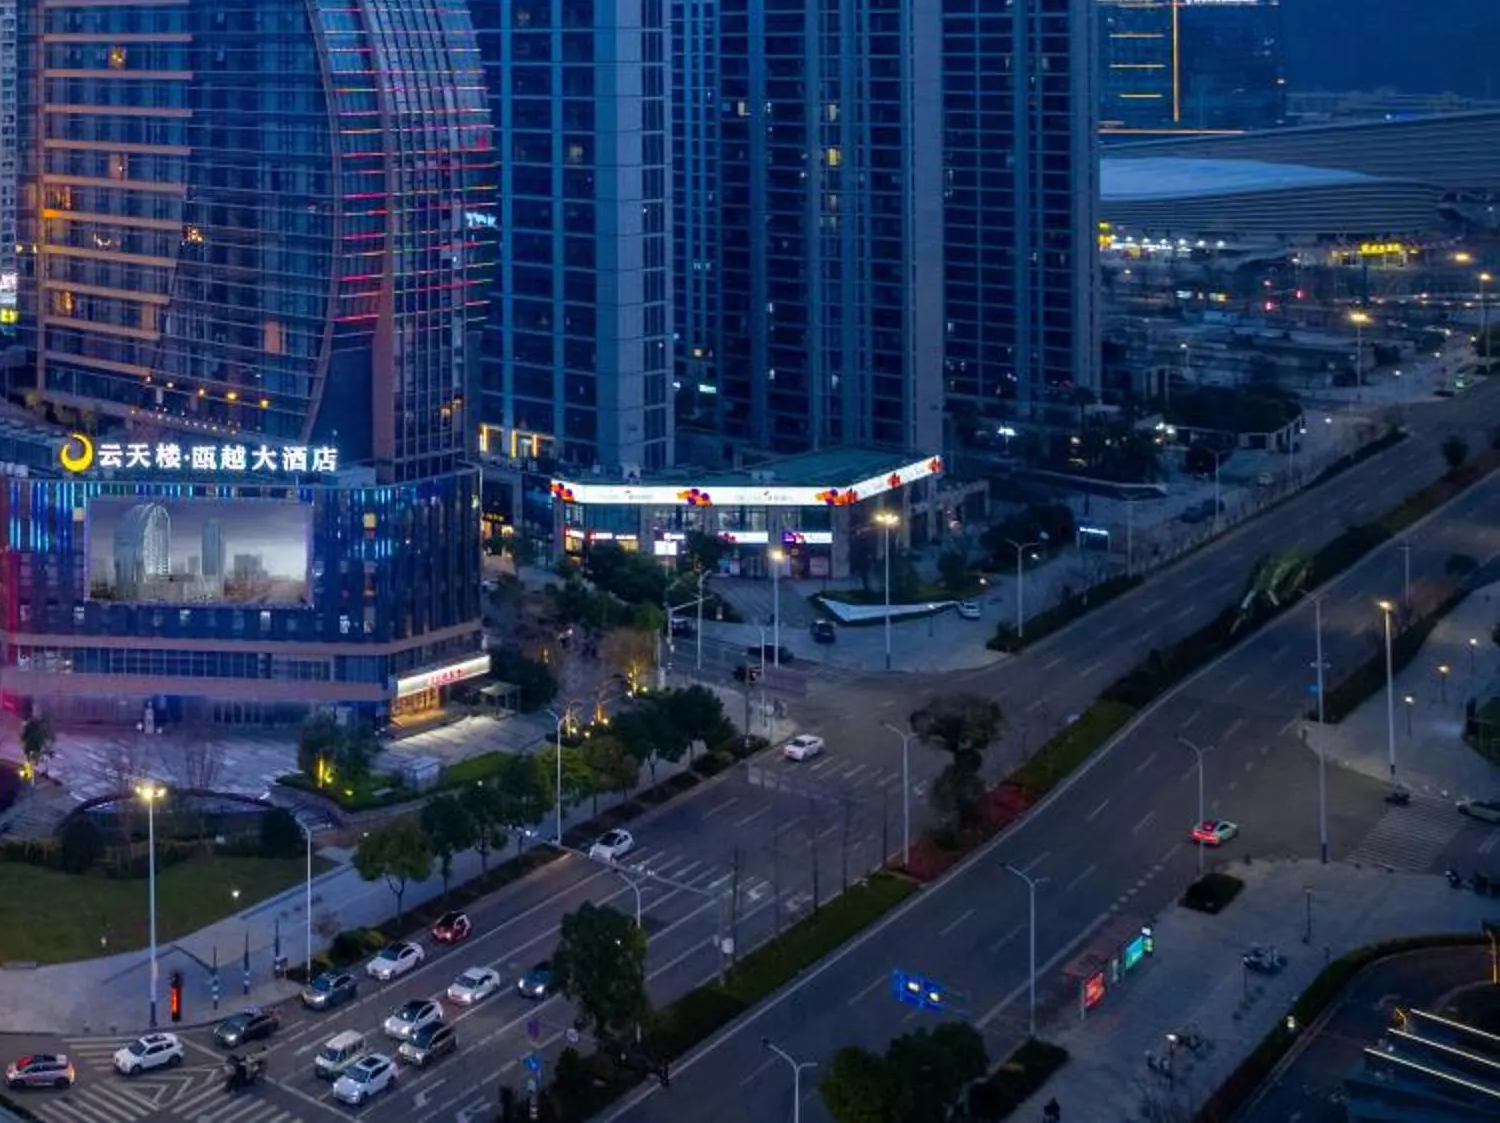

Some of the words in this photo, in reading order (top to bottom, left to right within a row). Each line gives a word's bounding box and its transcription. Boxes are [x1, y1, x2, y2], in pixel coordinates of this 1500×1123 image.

[98, 442, 338, 473] 云天楼·瓯越大酒店
